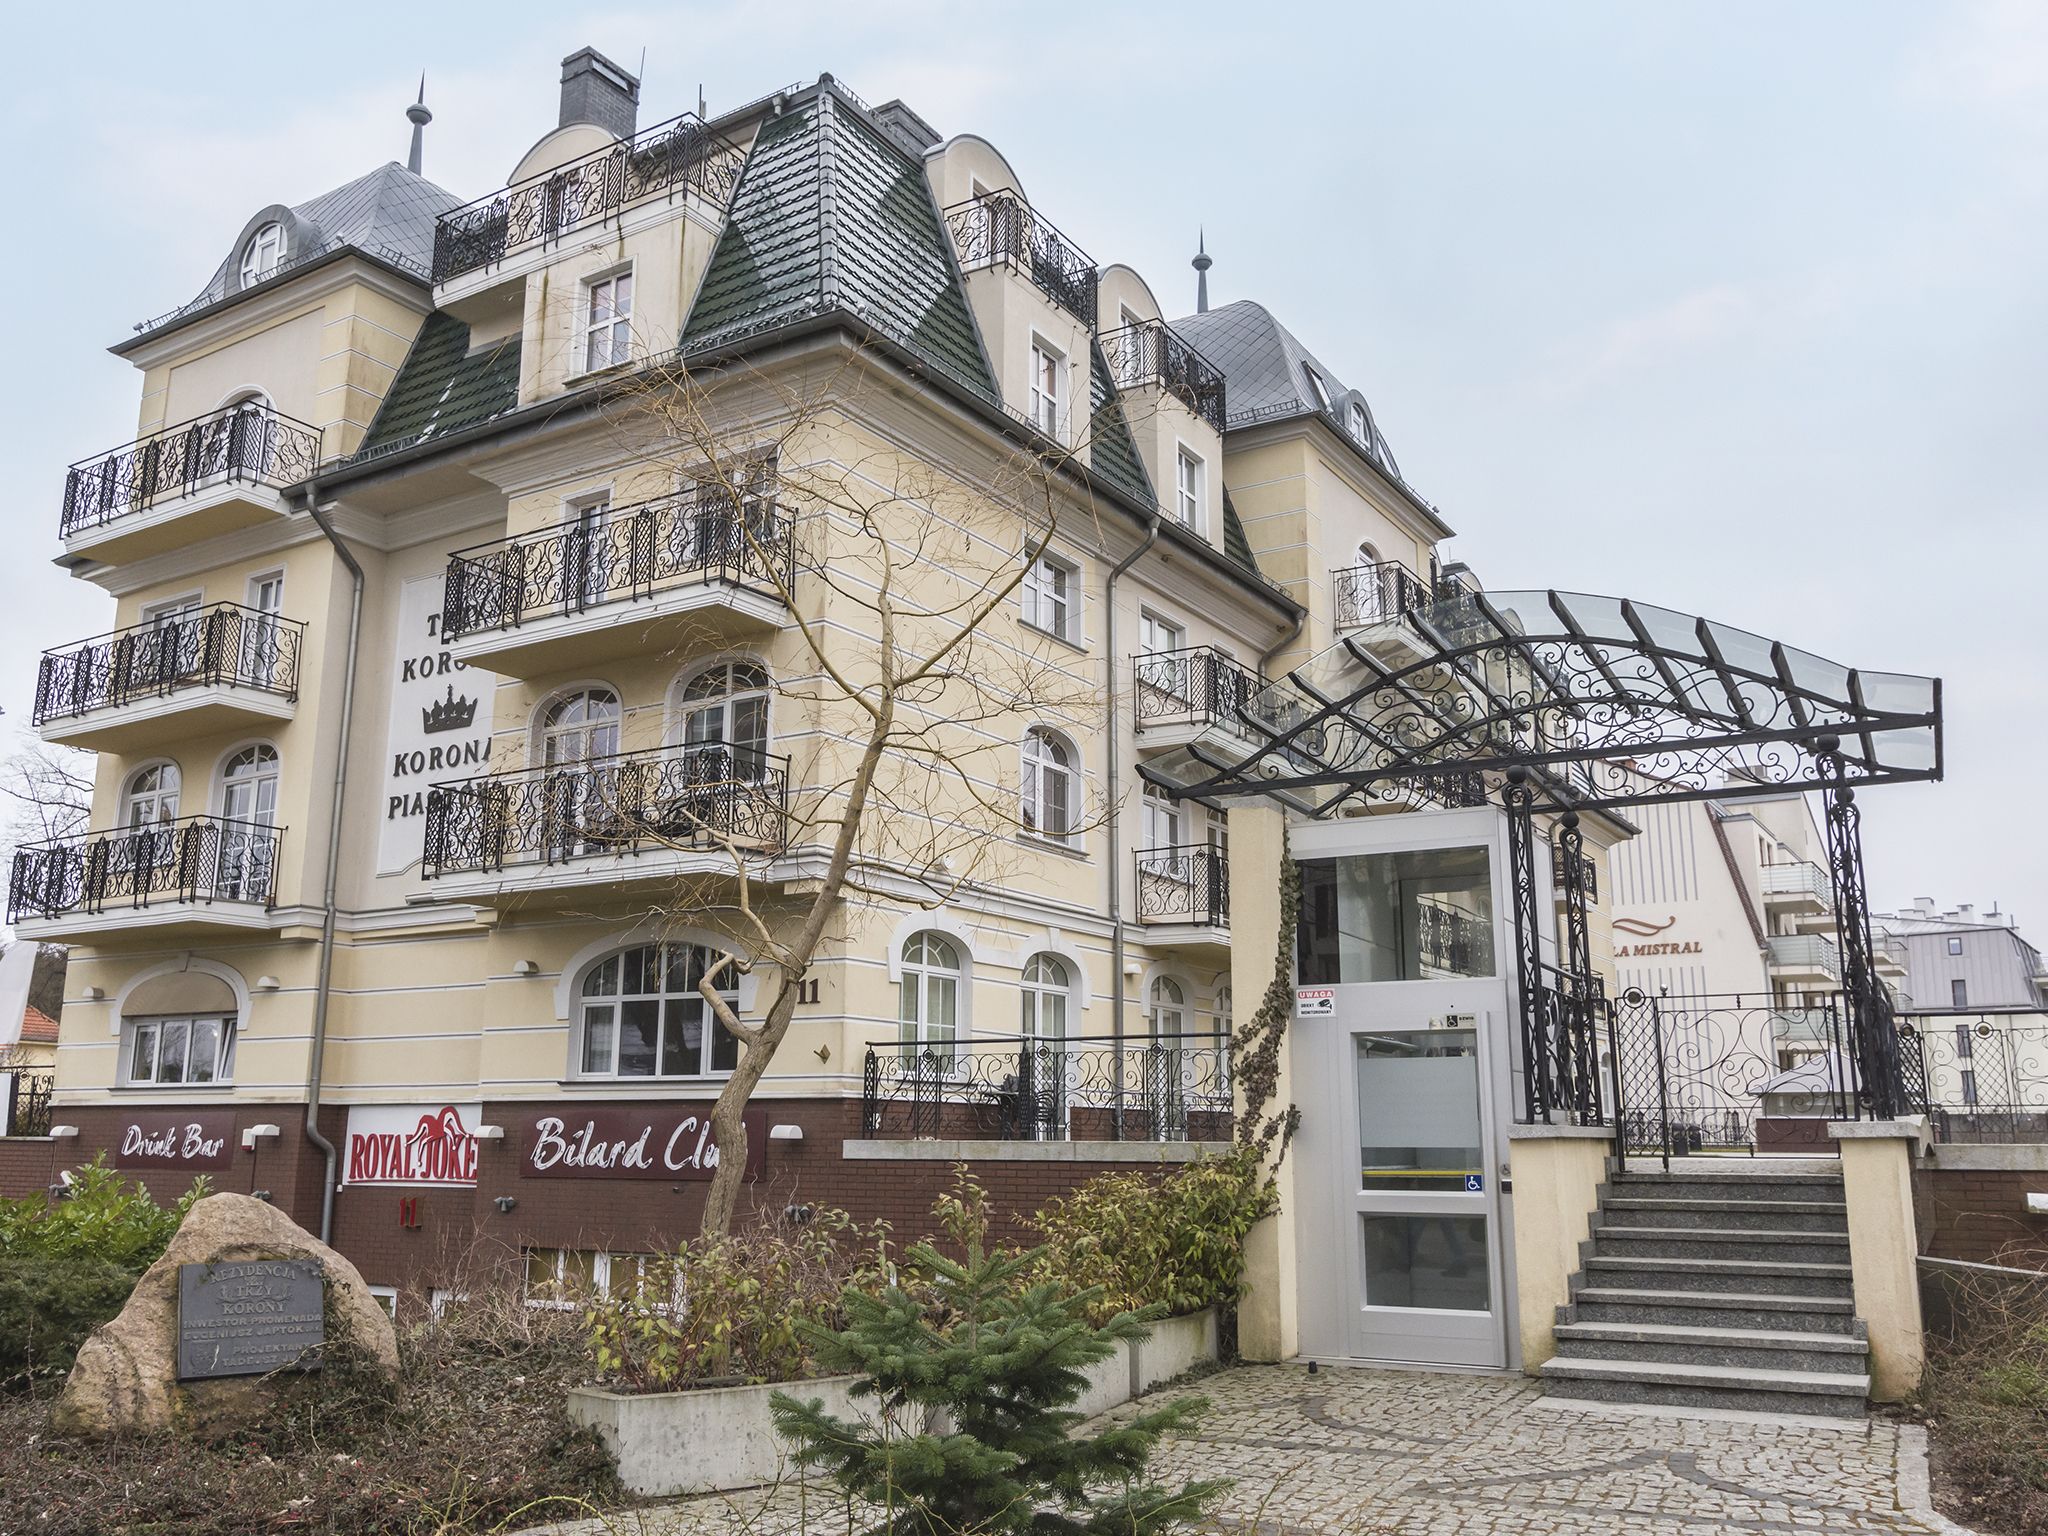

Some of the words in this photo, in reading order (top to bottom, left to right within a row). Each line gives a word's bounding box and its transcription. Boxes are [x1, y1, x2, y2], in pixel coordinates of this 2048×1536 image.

[1633, 942, 1702, 956] MISTRAL
[797, 978, 821, 1004] 11
[1299, 991, 1333, 999] UWAGA
[121, 1124, 176, 1158] Drink
[181, 1123, 224, 1159] Bar
[530, 1117, 653, 1170] Bilard
[663, 1116, 749, 1171] Clu
[348, 1133, 416, 1179] ROYAL
[210, 1264, 297, 1284] REZYDENCJA
[236, 1285, 273, 1297] TRZY
[221, 1301, 287, 1315] KORONY
